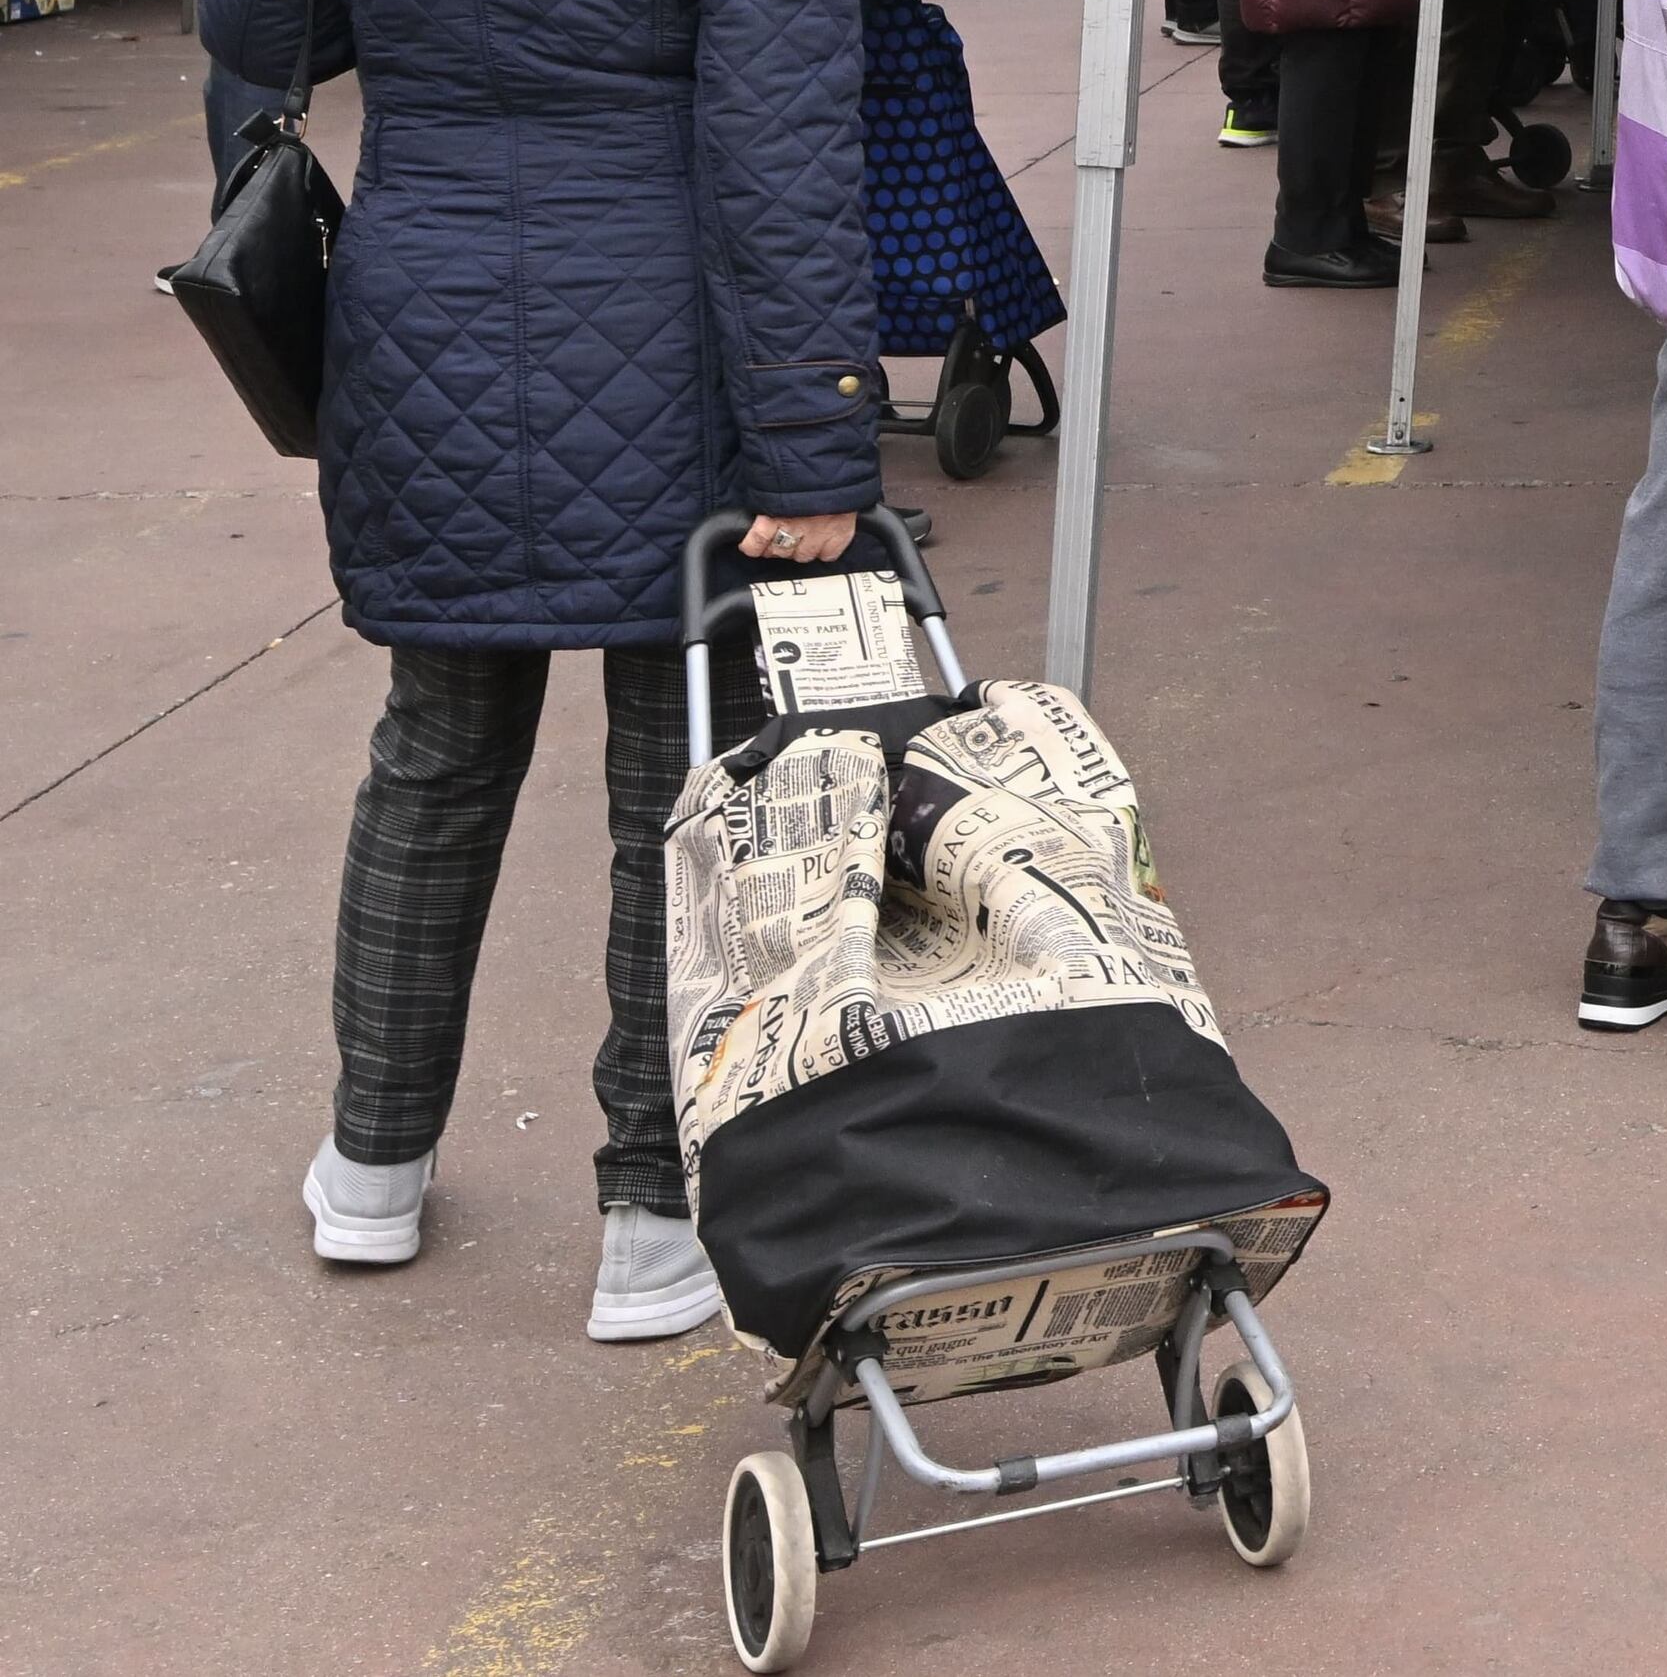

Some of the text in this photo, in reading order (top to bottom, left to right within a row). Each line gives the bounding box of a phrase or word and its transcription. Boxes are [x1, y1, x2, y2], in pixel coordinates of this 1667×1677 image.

[816, 624, 849, 635] PAPER
[936, 807, 999, 895] PEACE
[671, 847, 685, 907] Country
[999, 888, 1037, 947] Country
[926, 1335, 977, 1356] gagne
[971, 1351, 996, 1363] the
[998, 1340, 1070, 1358] laboratory
[1072, 1335, 1088, 1347] of
[1088, 1333, 1111, 1346] Art
